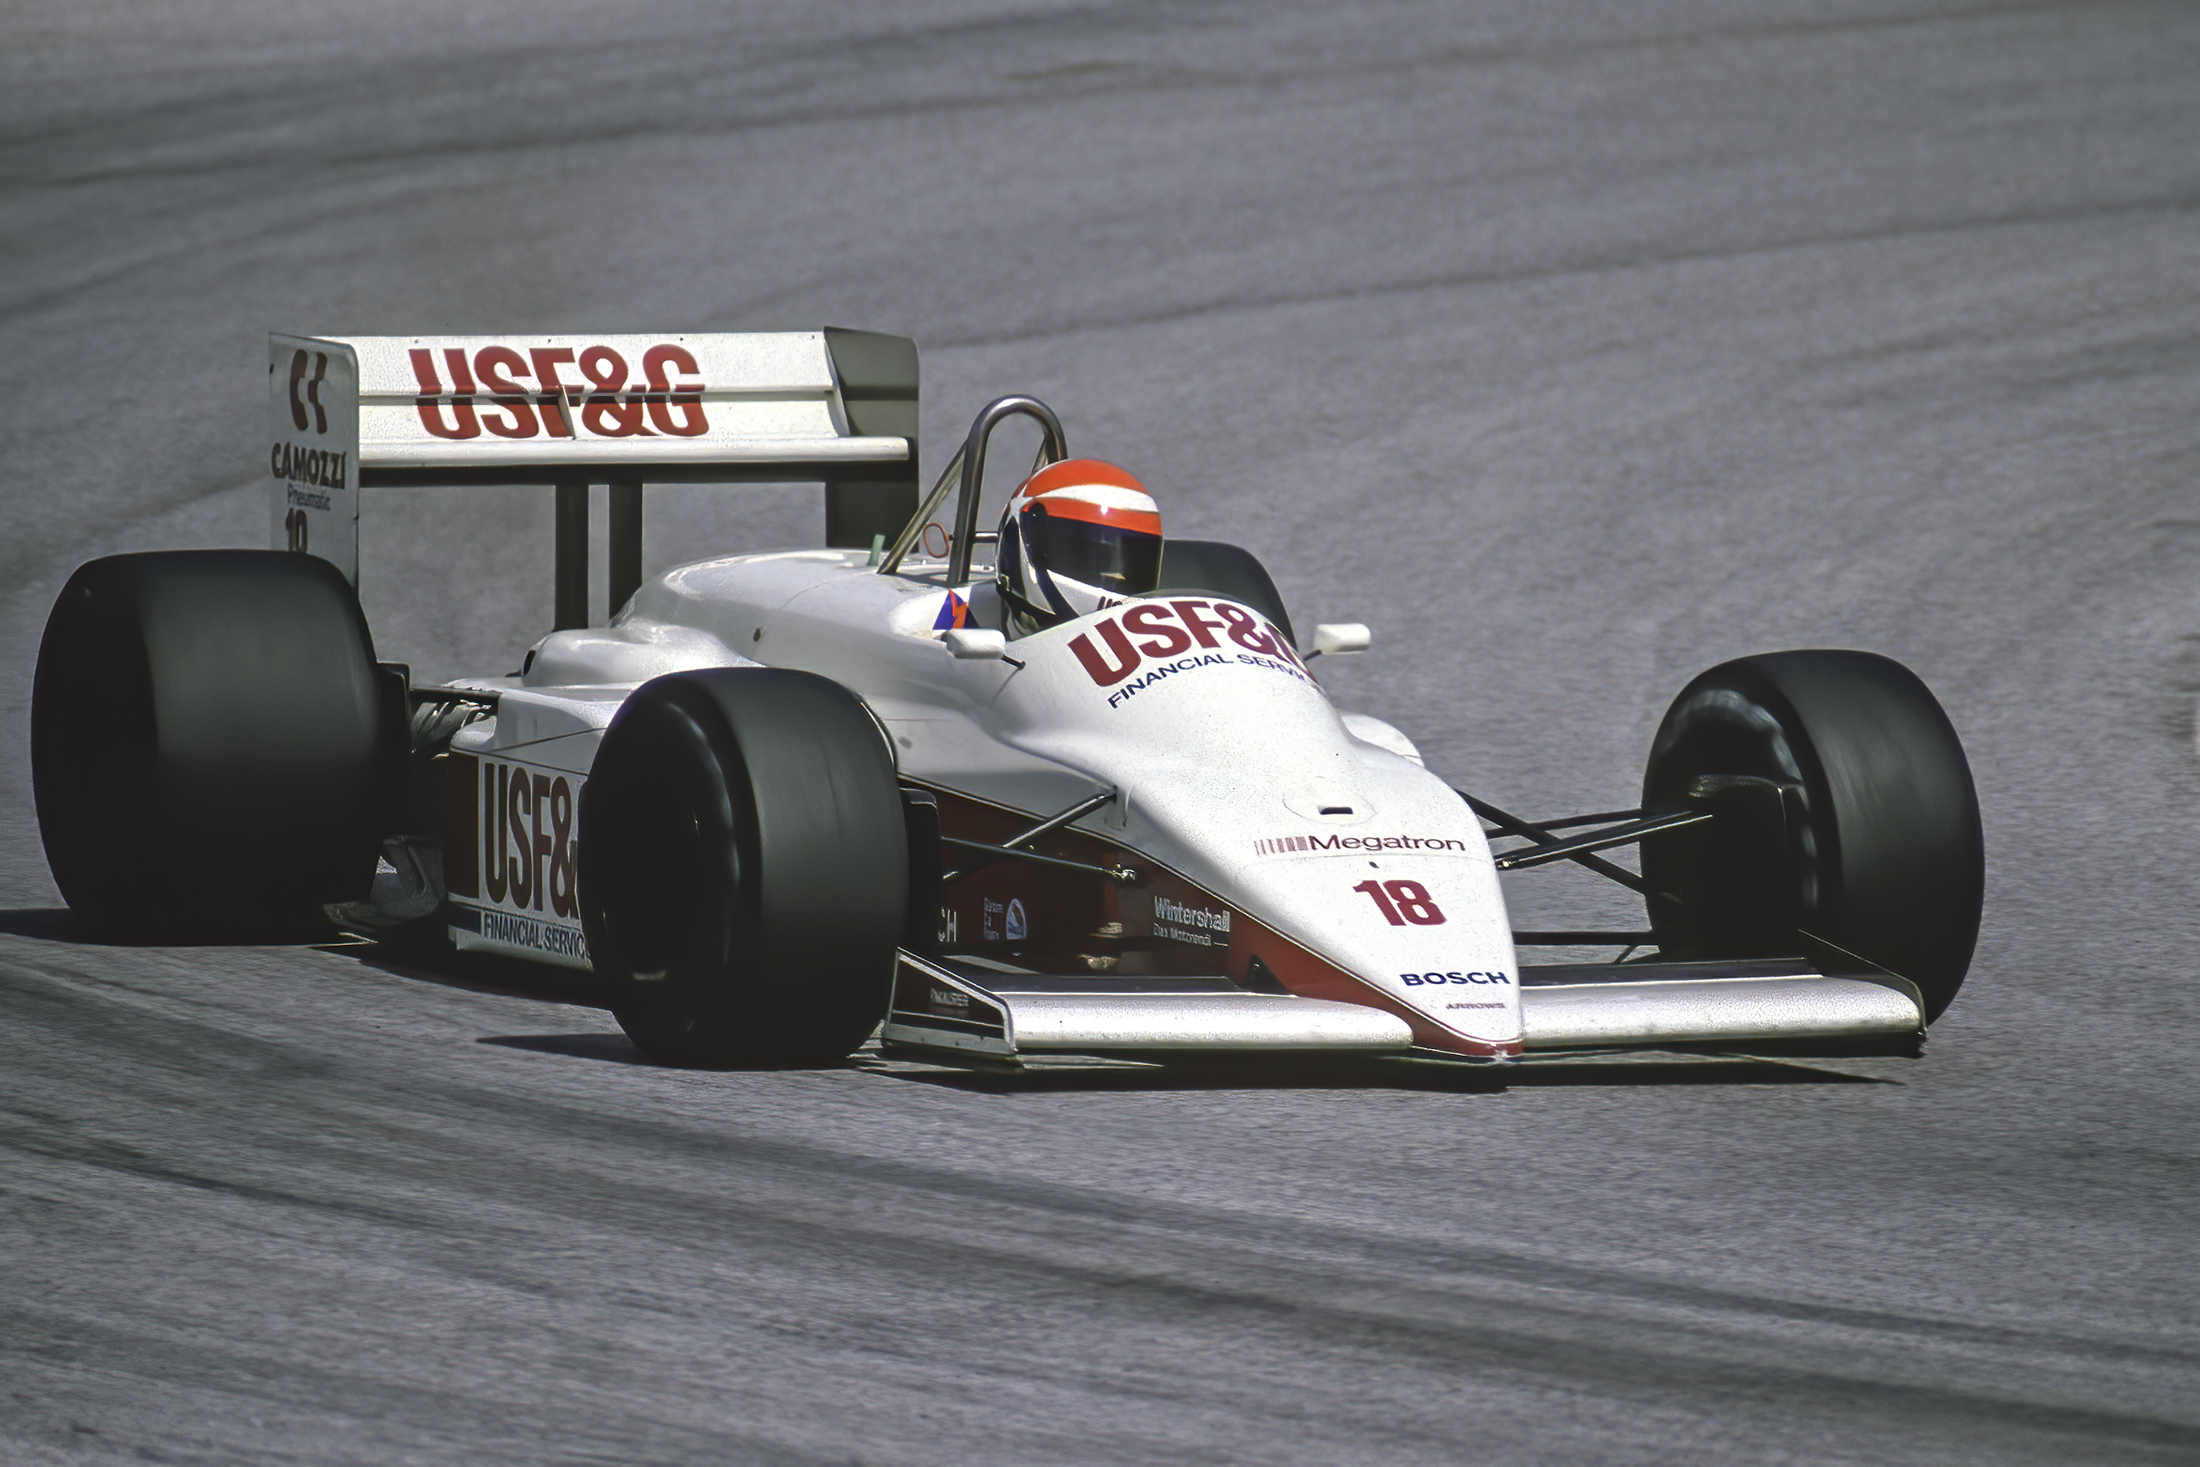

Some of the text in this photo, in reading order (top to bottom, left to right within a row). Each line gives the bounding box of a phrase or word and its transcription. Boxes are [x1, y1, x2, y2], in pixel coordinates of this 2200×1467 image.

[409, 343, 709, 439] USF&G
[272, 441, 346, 490] CAMOZZI
[1107, 653, 1234, 709] FINANCIAL
[1308, 834, 1465, 851] Megatron
[1154, 895, 1231, 932] Wintershall
[1353, 880, 1446, 926] 18
[484, 912, 542, 950] FINANCIAL
[1400, 972, 1511, 986] BOSCH
